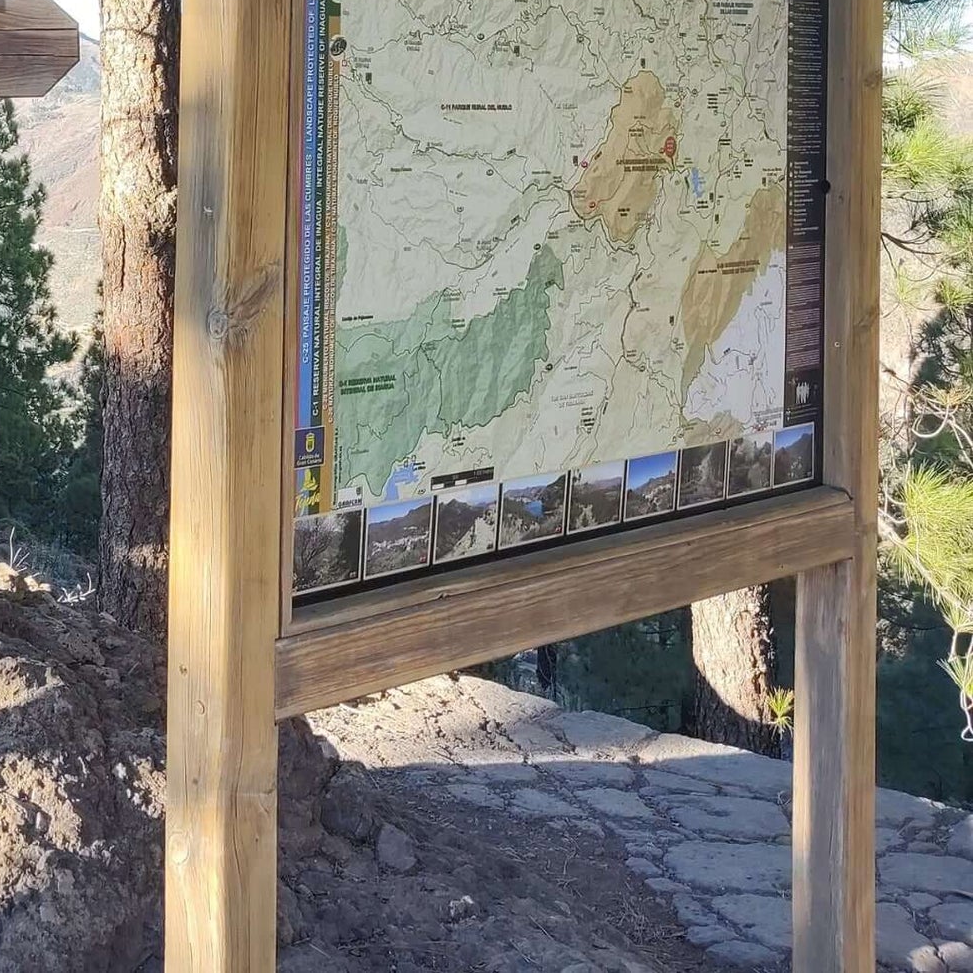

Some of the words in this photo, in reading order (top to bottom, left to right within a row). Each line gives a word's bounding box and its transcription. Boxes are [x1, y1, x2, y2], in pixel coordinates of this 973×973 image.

[308, 12, 315, 24] OF
[319, 39, 326, 52] OF
[316, 140, 324, 188] INTEGRAL
[305, 224, 312, 238] DE
[315, 199, 323, 237] INAGUA
[315, 238, 322, 252] DE
[304, 240, 312, 296] PROTEGIDO
[314, 253, 322, 302] INTEGRAL
[313, 303, 321, 349] NATURAL
